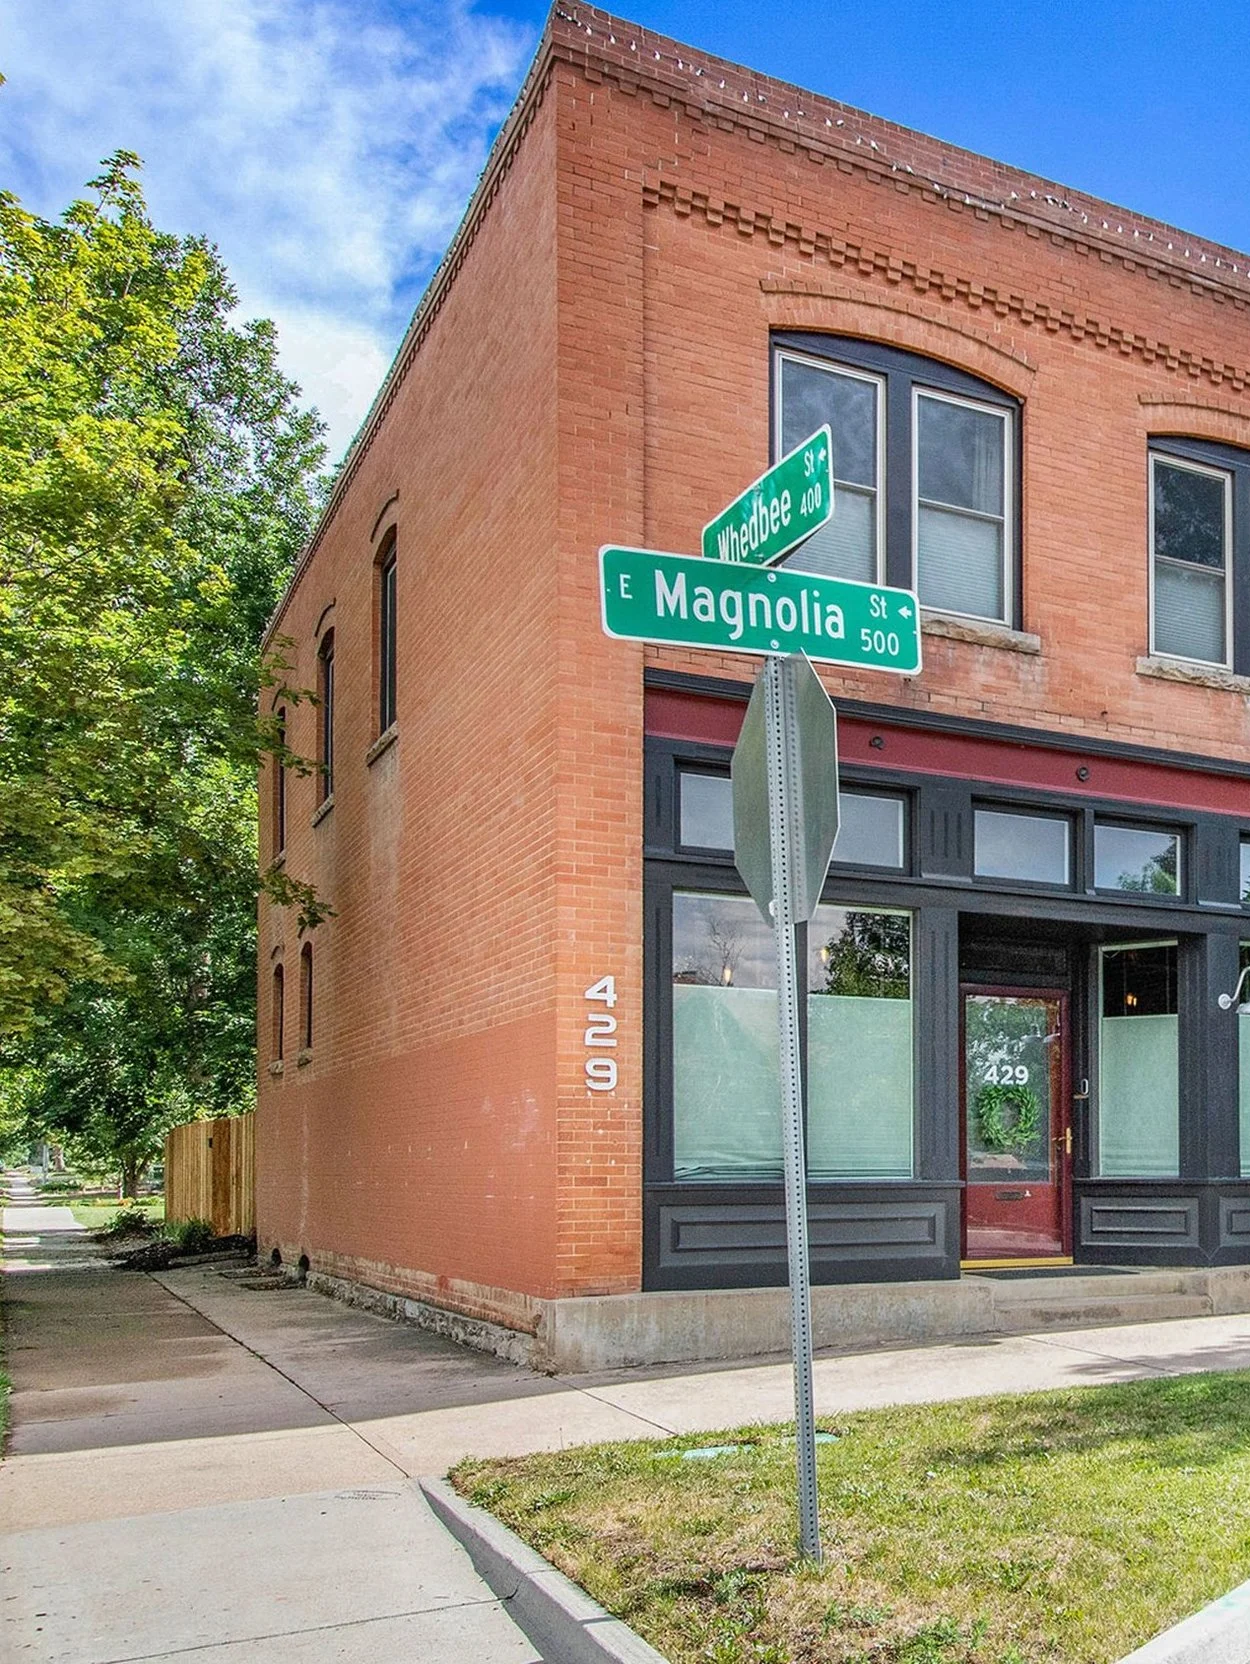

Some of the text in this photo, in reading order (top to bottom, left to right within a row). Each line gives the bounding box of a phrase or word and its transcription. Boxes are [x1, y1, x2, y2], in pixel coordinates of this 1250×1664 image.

[717, 451, 815, 562] Whedbee St
[800, 482, 821, 517] 400
[619, 569, 887, 640] E Magnolia St
[861, 628, 899, 656] 500
[584, 975, 618, 1091] 429
[984, 1065, 1029, 1085] 429
